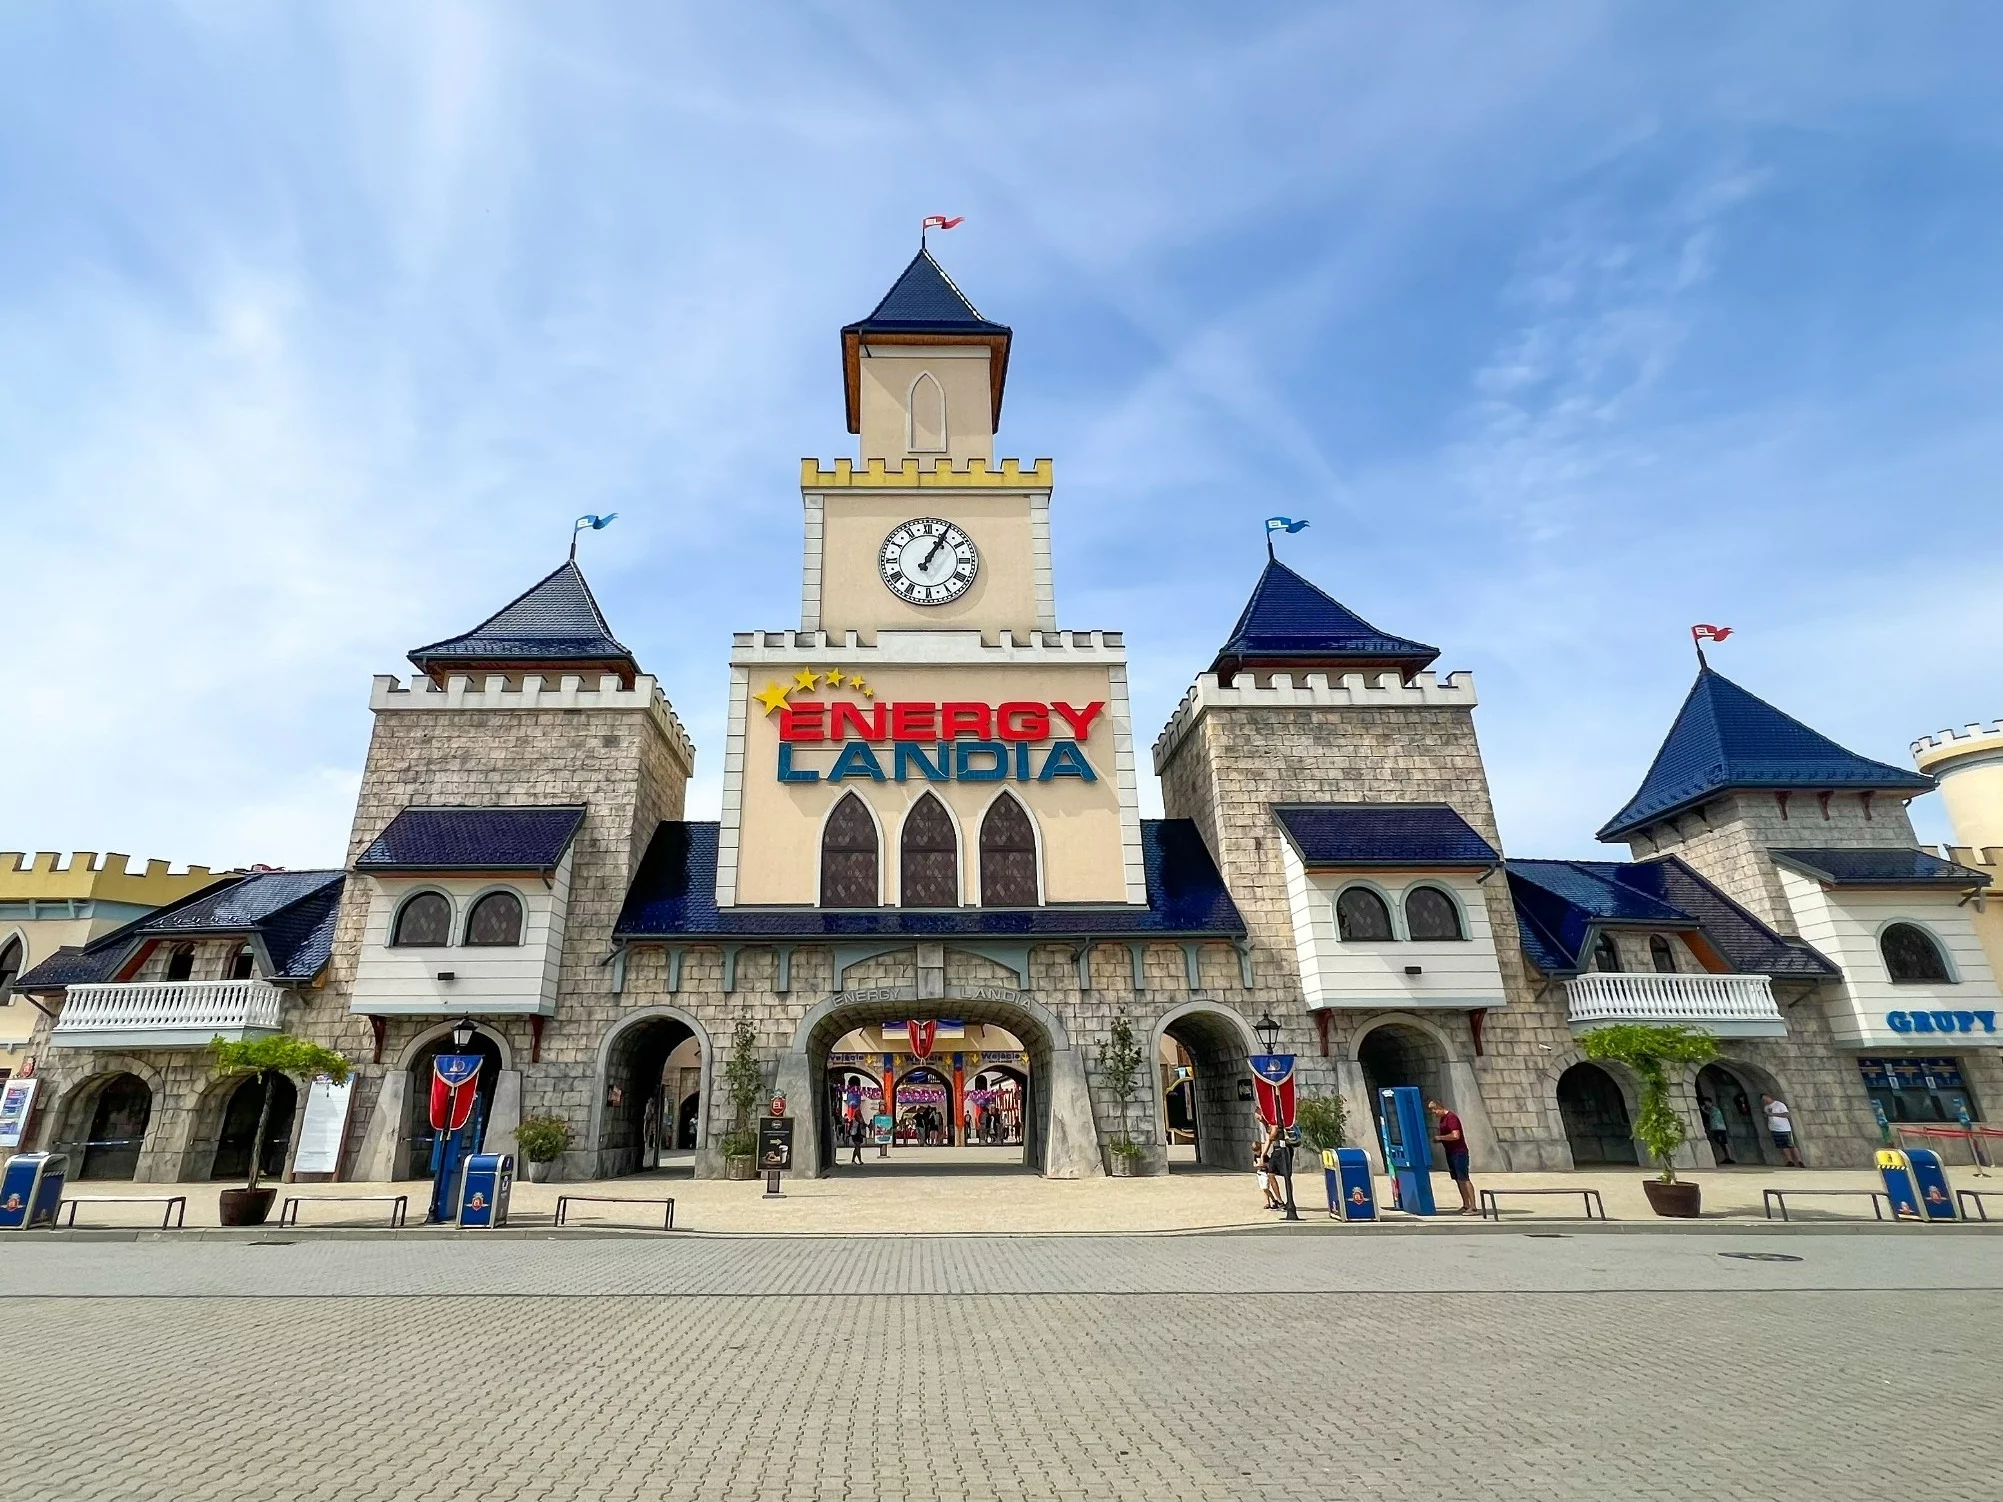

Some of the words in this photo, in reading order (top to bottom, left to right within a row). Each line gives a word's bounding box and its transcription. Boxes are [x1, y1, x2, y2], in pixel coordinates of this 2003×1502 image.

[779, 701, 1105, 741] ENERGY
[777, 741, 1098, 783] LANDIA
[833, 988, 900, 1007] ENERGY
[961, 988, 1031, 1010] LANDIA
[1886, 1010, 1996, 1033] GRUPY
